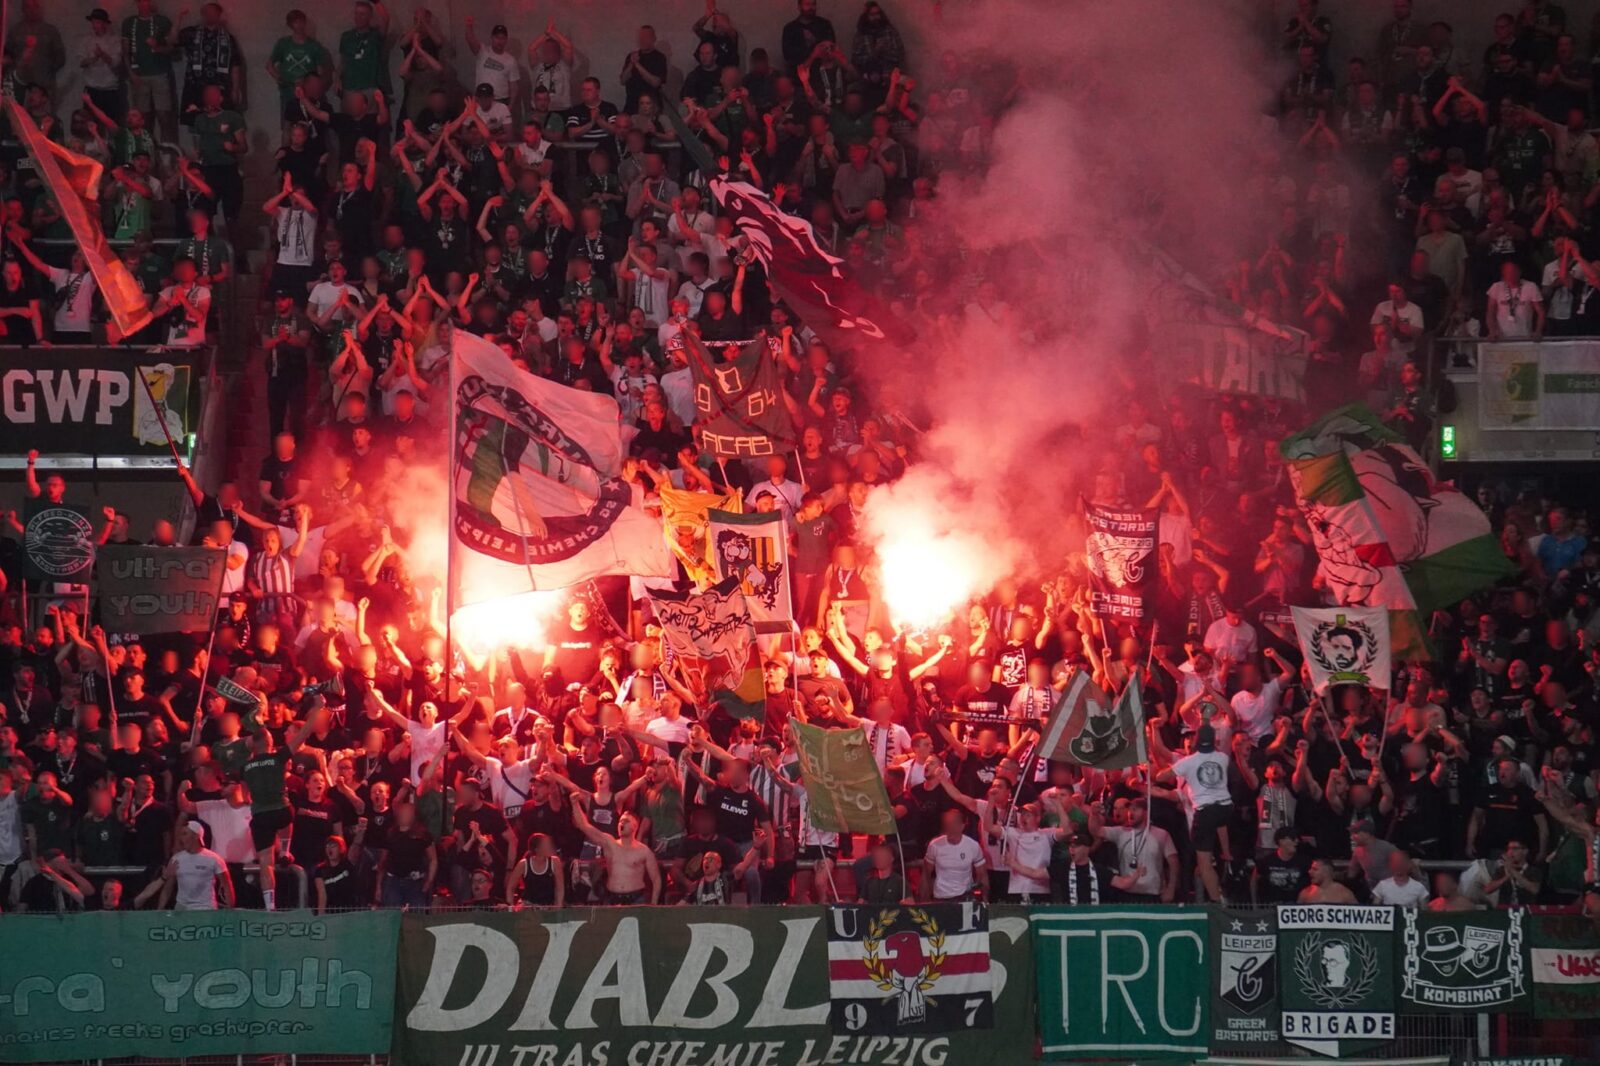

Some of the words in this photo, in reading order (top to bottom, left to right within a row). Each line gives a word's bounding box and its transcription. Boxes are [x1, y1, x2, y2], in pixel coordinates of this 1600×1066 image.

[2, 368, 130, 425] GWP
[702, 430, 774, 456] ACAB
[833, 908, 858, 938] U
[957, 902, 980, 932] F
[1280, 908, 1324, 924] GEORG
[1327, 909, 1392, 925] SCHWARZ
[1224, 938, 1274, 949] LEIPZIG
[1469, 929, 1500, 941] LEIPZIG
[1038, 929, 1203, 1036] TRC
[1423, 987, 1502, 1003] KOMBINAT
[844, 1004, 868, 1030] 9
[964, 999, 986, 1027] 7
[1227, 1018, 1266, 1029] GREEN
[1285, 1015, 1392, 1035] BRIGADE
[1215, 1029, 1279, 1042] BASTARDS
[796, 1035, 950, 1066] LEIPZIG
